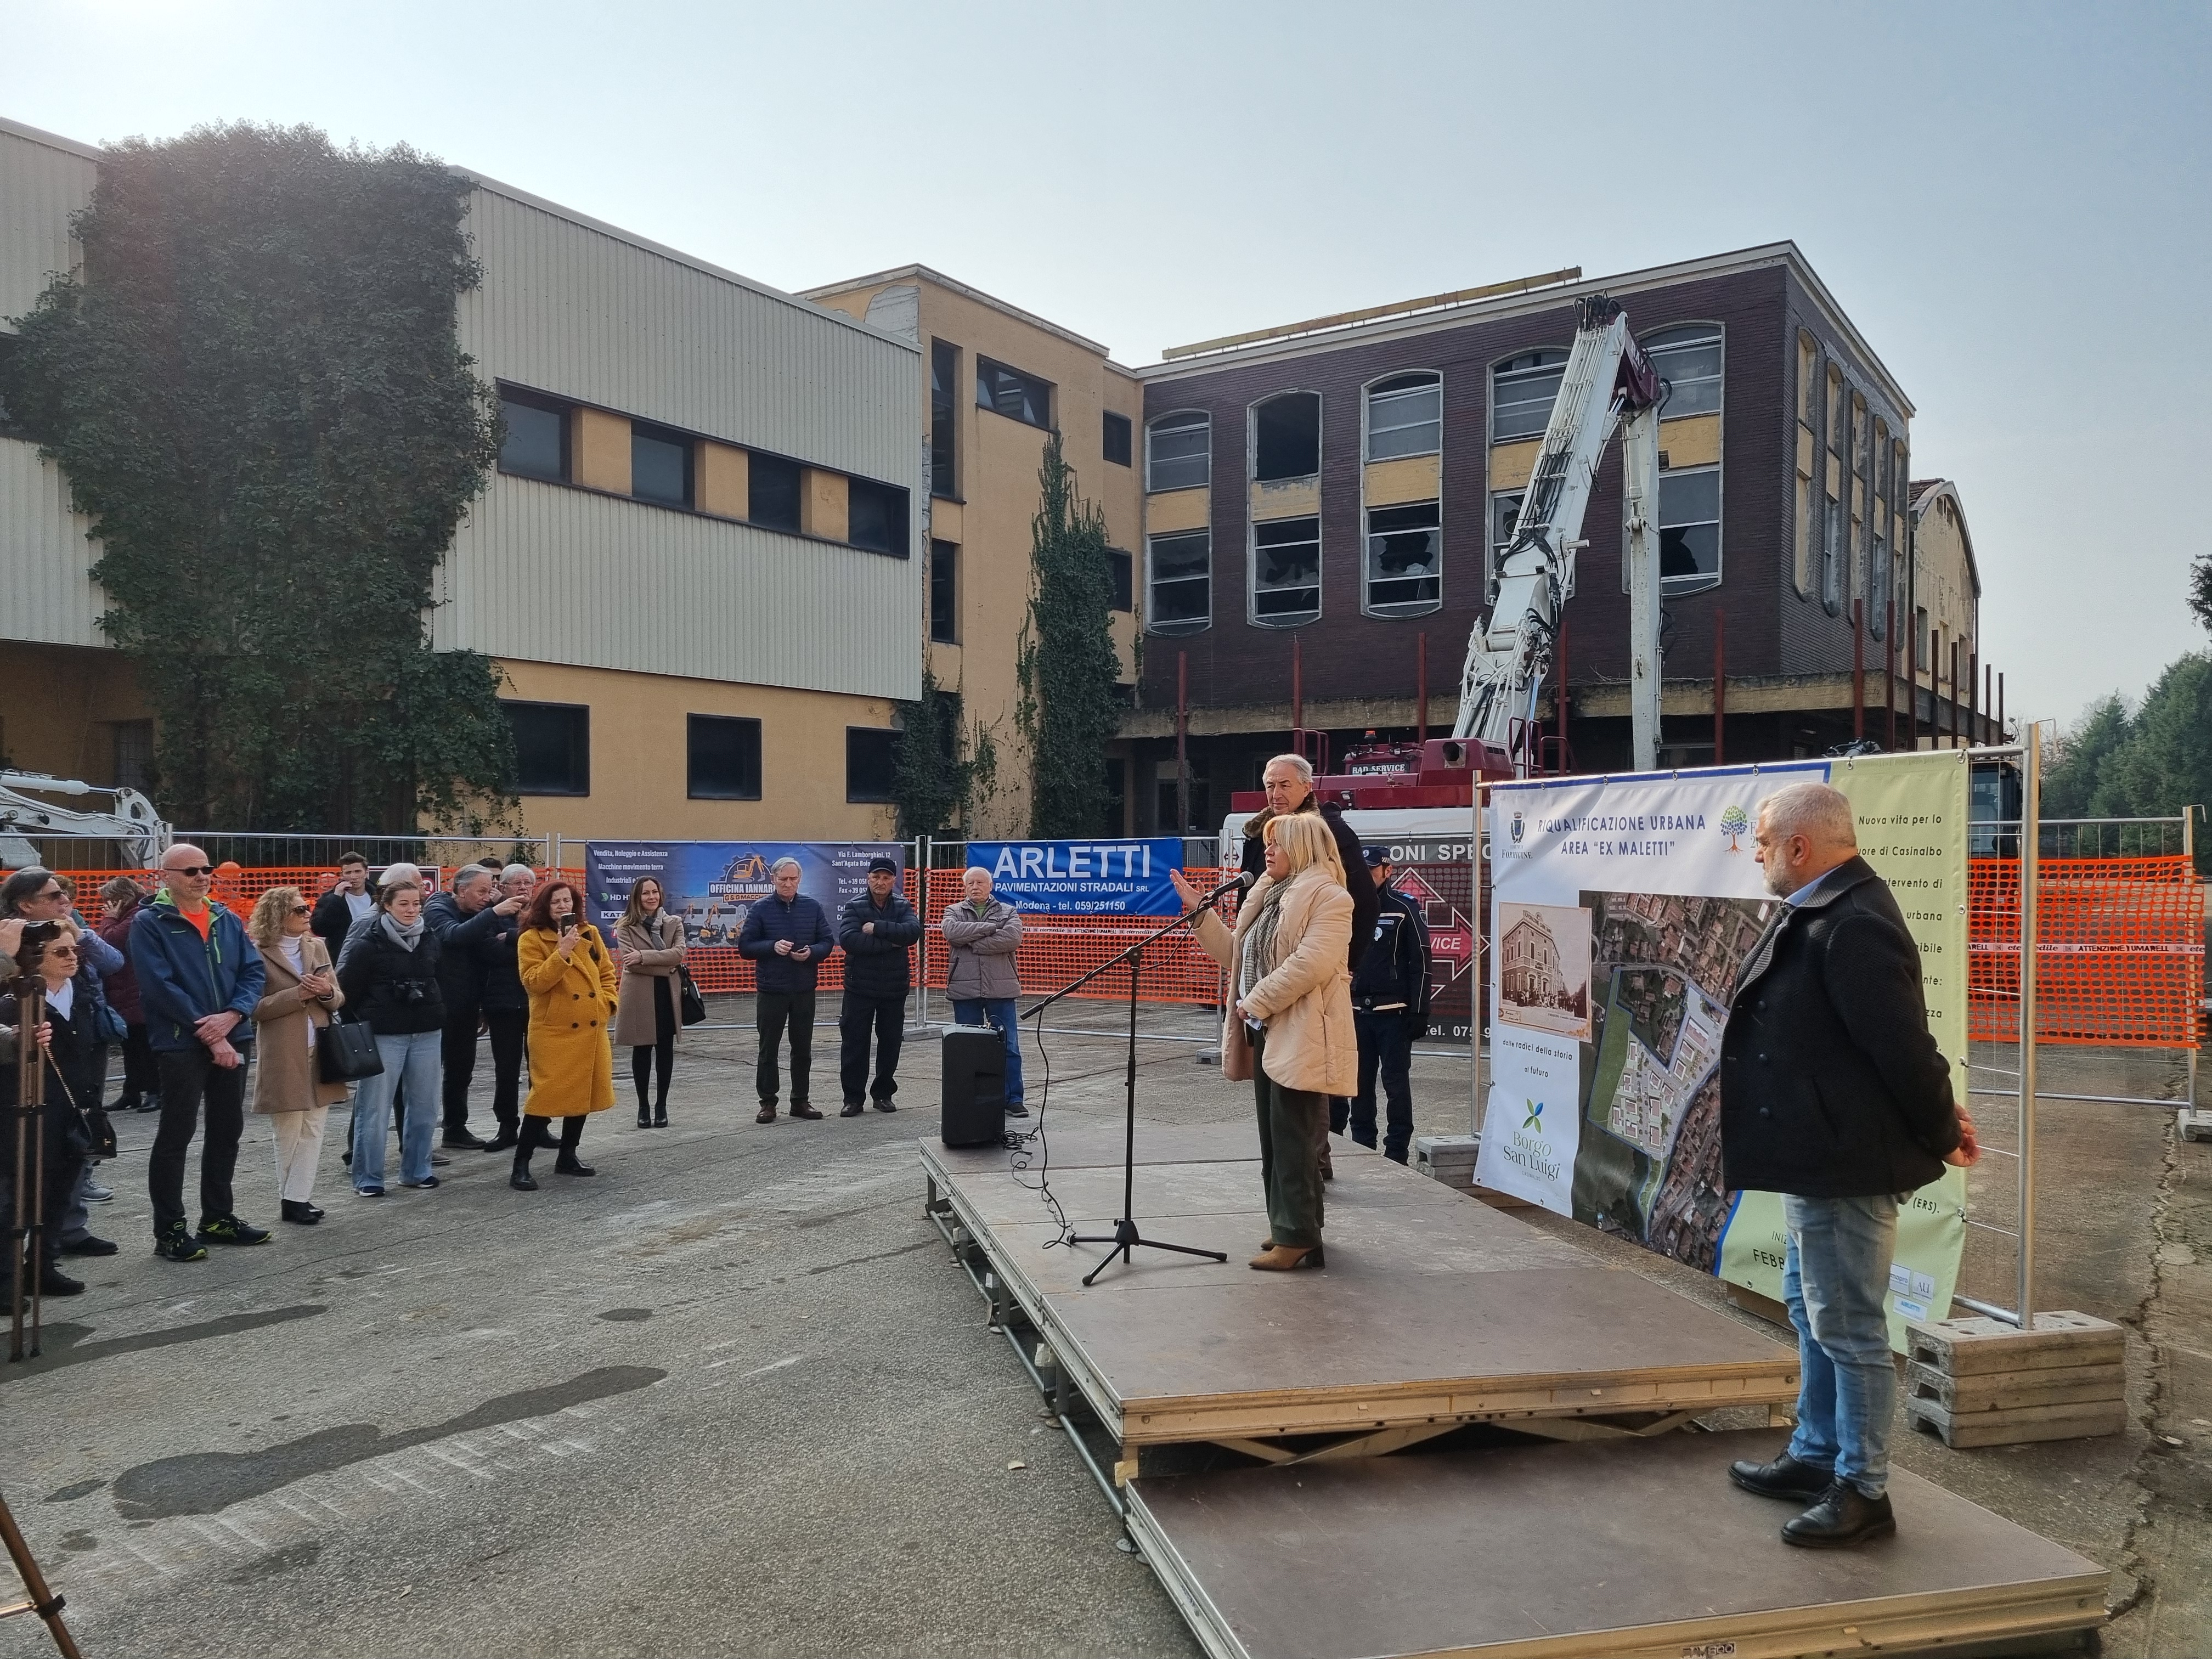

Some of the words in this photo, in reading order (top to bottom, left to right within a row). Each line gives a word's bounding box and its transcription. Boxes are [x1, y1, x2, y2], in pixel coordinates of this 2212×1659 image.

[1371, 764, 1405, 772] SERVICE
[1537, 816, 1644, 833] RIQUALIFICAZIONE
[1650, 815, 1706, 830] URBANA
[1859, 816, 1887, 825] Nuova
[1891, 815, 1909, 824] vita
[1912, 816, 1928, 826] per
[1932, 814, 1942, 823] lo
[1561, 841, 1589, 855] AREA
[1880, 847, 1888, 856] di
[1892, 846, 1942, 856] Casinalbo
[614, 850, 636, 858] Noleggio
[994, 845, 1150, 878] ARLETTI
[710, 884, 744, 893] OFFICINA
[995, 882, 1077, 893] PAVIMENTAZIONI
[1080, 882, 1133, 893] STRADALI
[1933, 879, 1943, 888] di
[1015, 900, 1050, 910] Modena
[1058, 901, 1073, 910] tel.
[1075, 901, 1125, 911] 059/251150
[1906, 910, 1942, 921] urbana
[1516, 1042, 1533, 1052] radici
[1536, 1045, 1551, 1056] della
[1554, 1049, 1572, 1060] storia
[1530, 1066, 1549, 1077] futuro
[1514, 1131, 1551, 1158] Borgo
[1503, 1146, 1526, 1166] San
[1530, 1154, 1560, 1181] Luigi
[1913, 1197, 1940, 1214] (ERS).
[1753, 1249, 1785, 1270] FEBB
